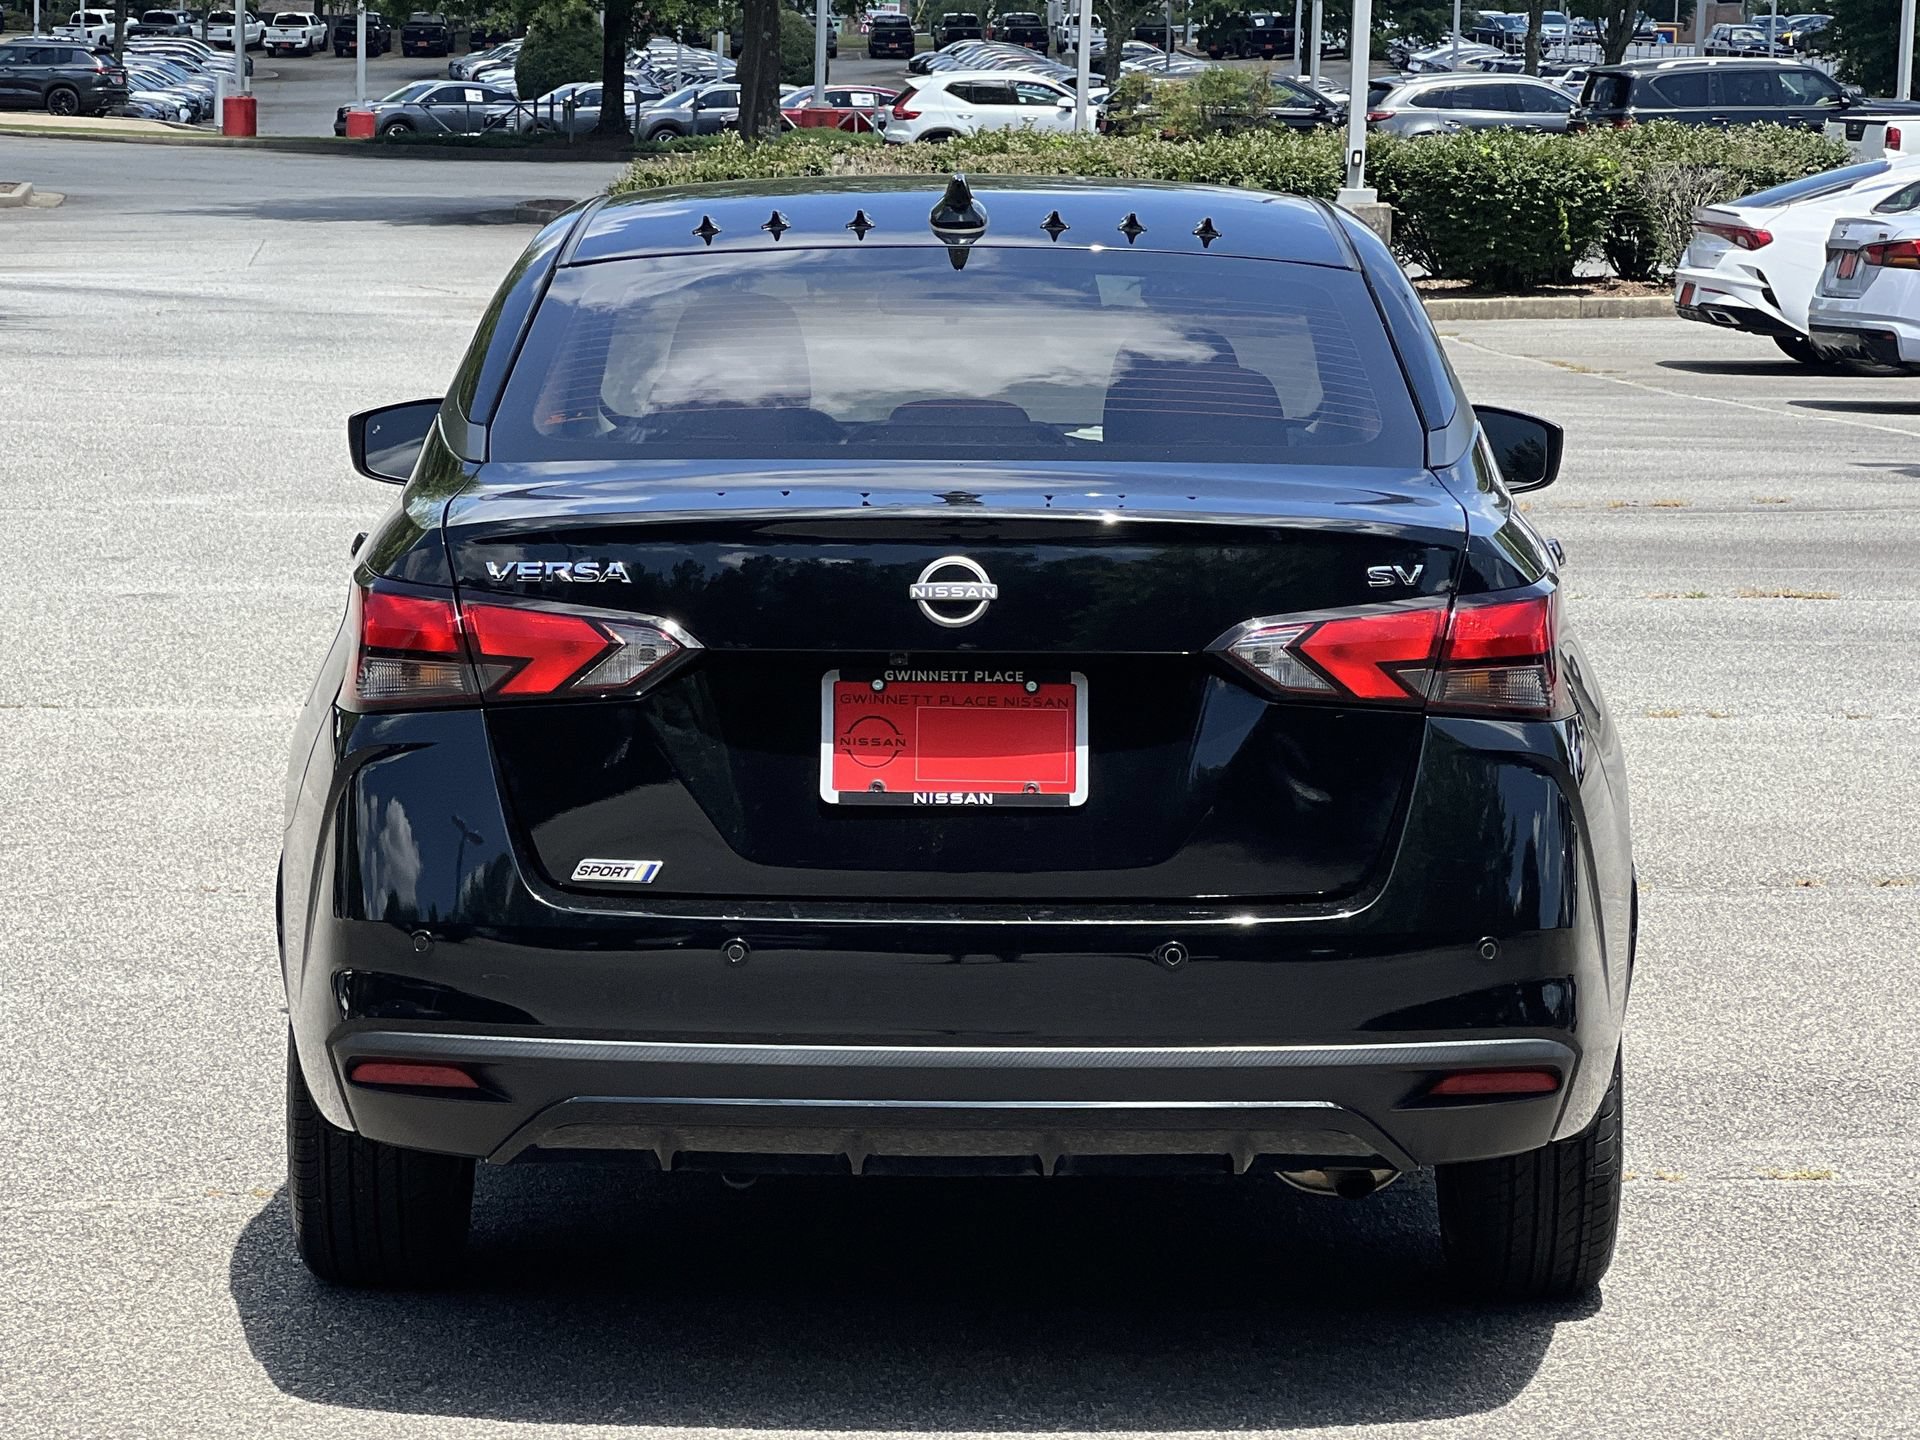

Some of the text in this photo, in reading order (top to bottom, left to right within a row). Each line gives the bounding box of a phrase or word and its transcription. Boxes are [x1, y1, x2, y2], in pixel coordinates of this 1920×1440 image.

[485, 561, 632, 583] VERSA
[1367, 564, 1424, 587] SV
[911, 586, 996, 598] NISSAN
[884, 670, 1024, 682] GWINNETT PLACE
[840, 693, 1069, 708] GWINNETT PLACE NISSAN
[840, 737, 906, 747] NISSAN
[913, 792, 994, 805] NISSAN
[577, 865, 635, 878] SPORT
